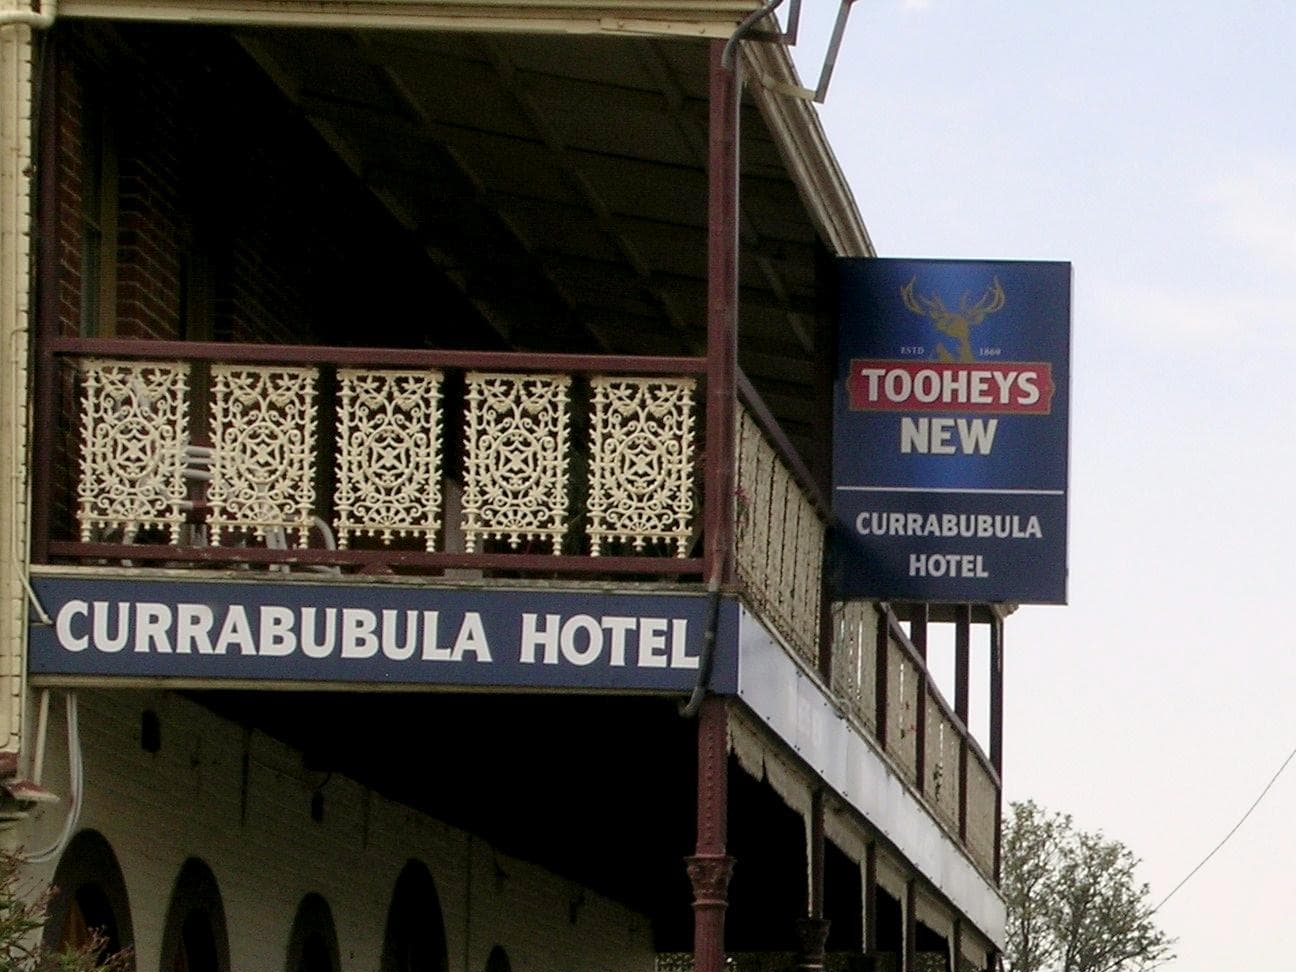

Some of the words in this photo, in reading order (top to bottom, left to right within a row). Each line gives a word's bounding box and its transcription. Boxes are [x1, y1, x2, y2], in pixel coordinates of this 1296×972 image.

[861, 368, 1040, 405] TOOHEYS
[900, 417, 998, 454] NEW
[855, 512, 1043, 539] CURRABUBULA
[908, 553, 989, 578] HOTEL
[55, 600, 492, 662] CURRABUBULA
[518, 613, 700, 668] HOTEL
